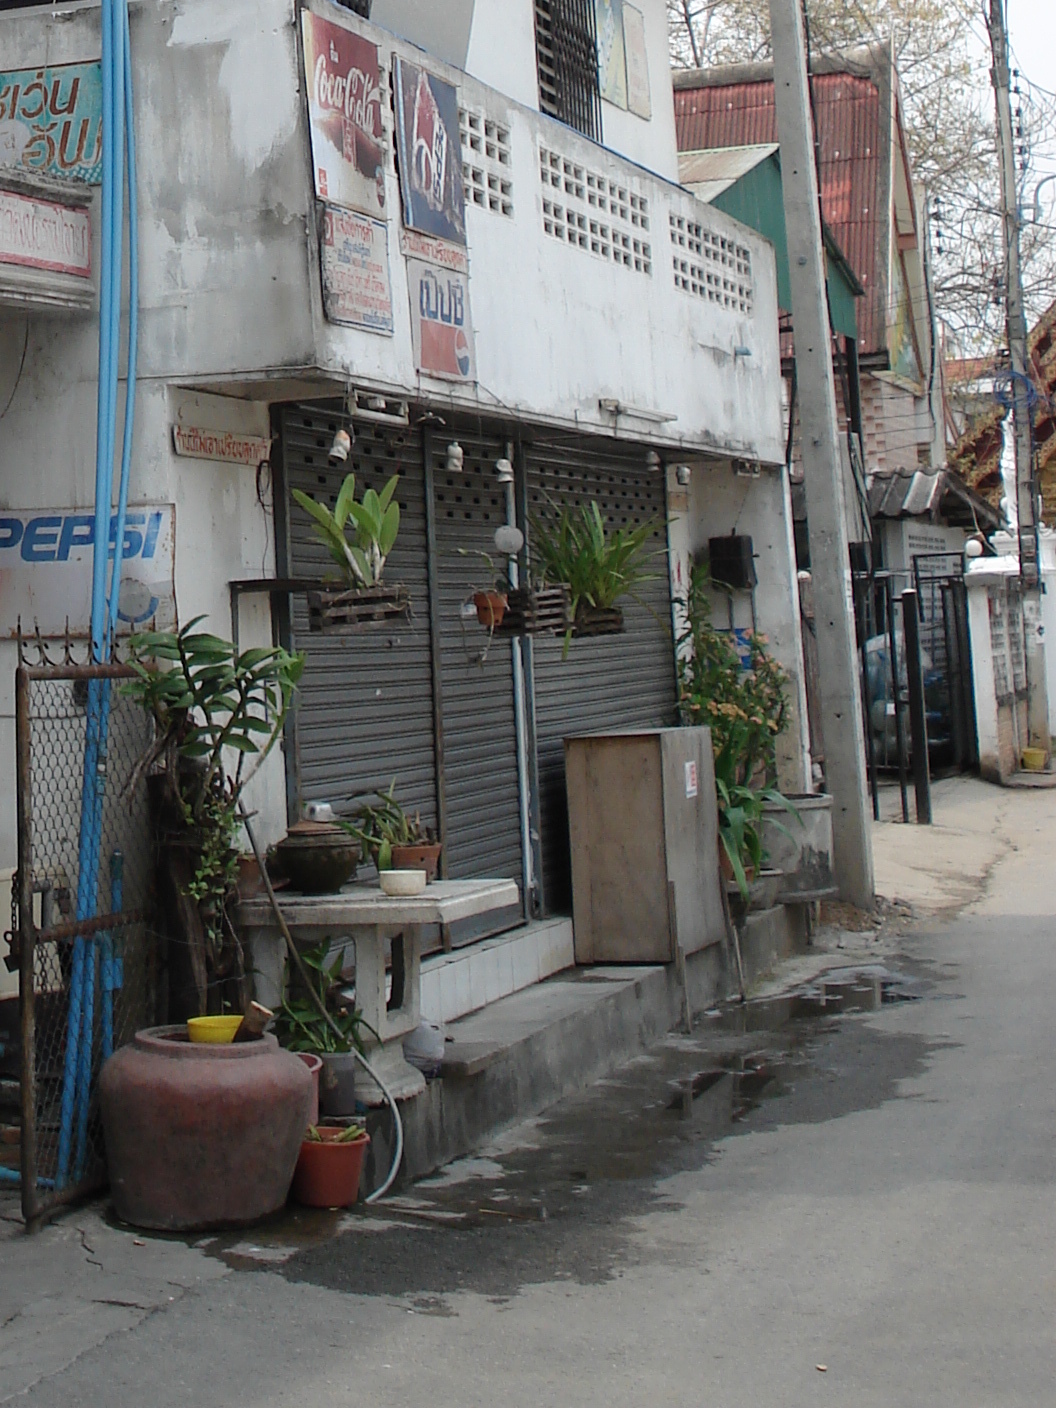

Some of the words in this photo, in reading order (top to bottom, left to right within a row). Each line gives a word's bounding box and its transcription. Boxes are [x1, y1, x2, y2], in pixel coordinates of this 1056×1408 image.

[314, 53, 377, 133] Coca-Cola
[419, 269, 465, 326] เป๊ปซี่
